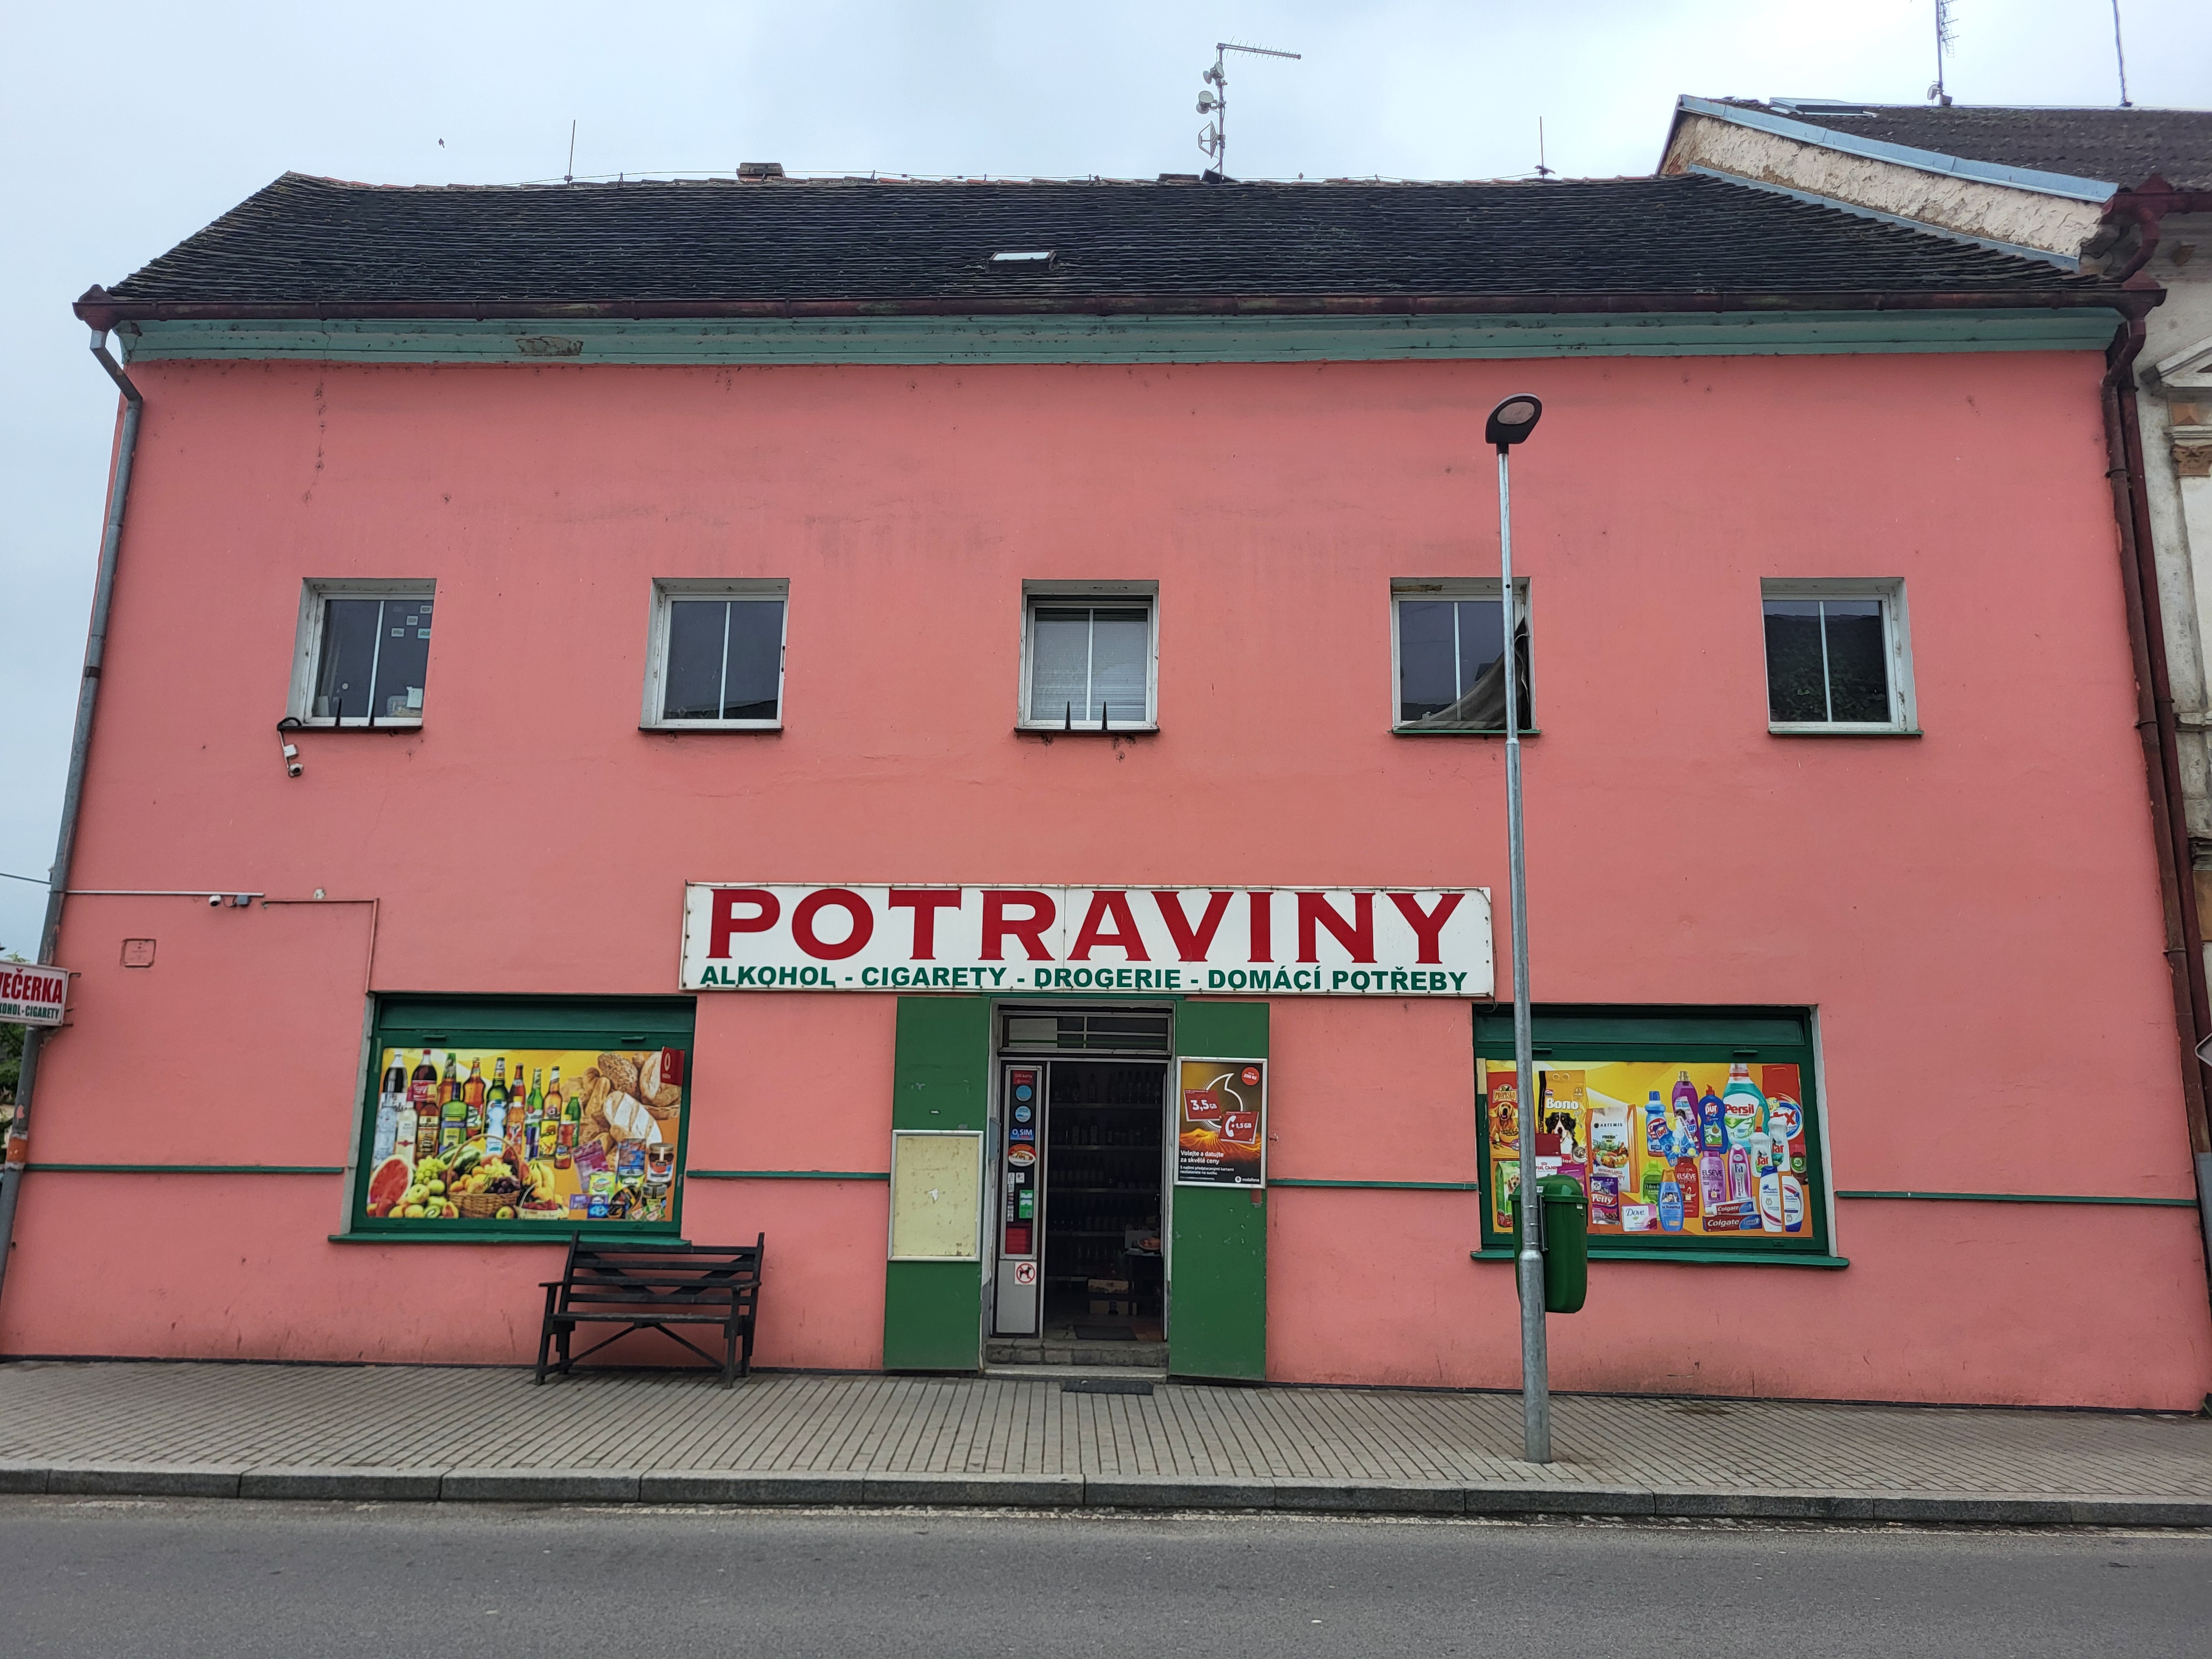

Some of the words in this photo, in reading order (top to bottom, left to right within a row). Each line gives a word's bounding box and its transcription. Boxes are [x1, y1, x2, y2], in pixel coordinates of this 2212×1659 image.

[706, 886, 1465, 964] POTRAVINY
[700, 966, 836, 987] ALKOHOL
[861, 967, 1008, 987] CIGARETY
[1034, 968, 1182, 988] DROGERIE
[1208, 965, 1322, 990] DOMÁCÍ
[1333, 966, 1469, 992] POTŘEBY
[25, 1005, 59, 1019] CIGARETY
[1546, 1097, 1579, 1110] Bono
[1724, 1103, 1755, 1114] Persil
[1705, 1104, 1718, 1115] pur
[1772, 1145, 1784, 1154] Jar
[1757, 1156, 1769, 1166] Jar
[1734, 1163, 1744, 1173] Fa
[1592, 1194, 1613, 1205] Petty
[1625, 1208, 1645, 1217] Dove
